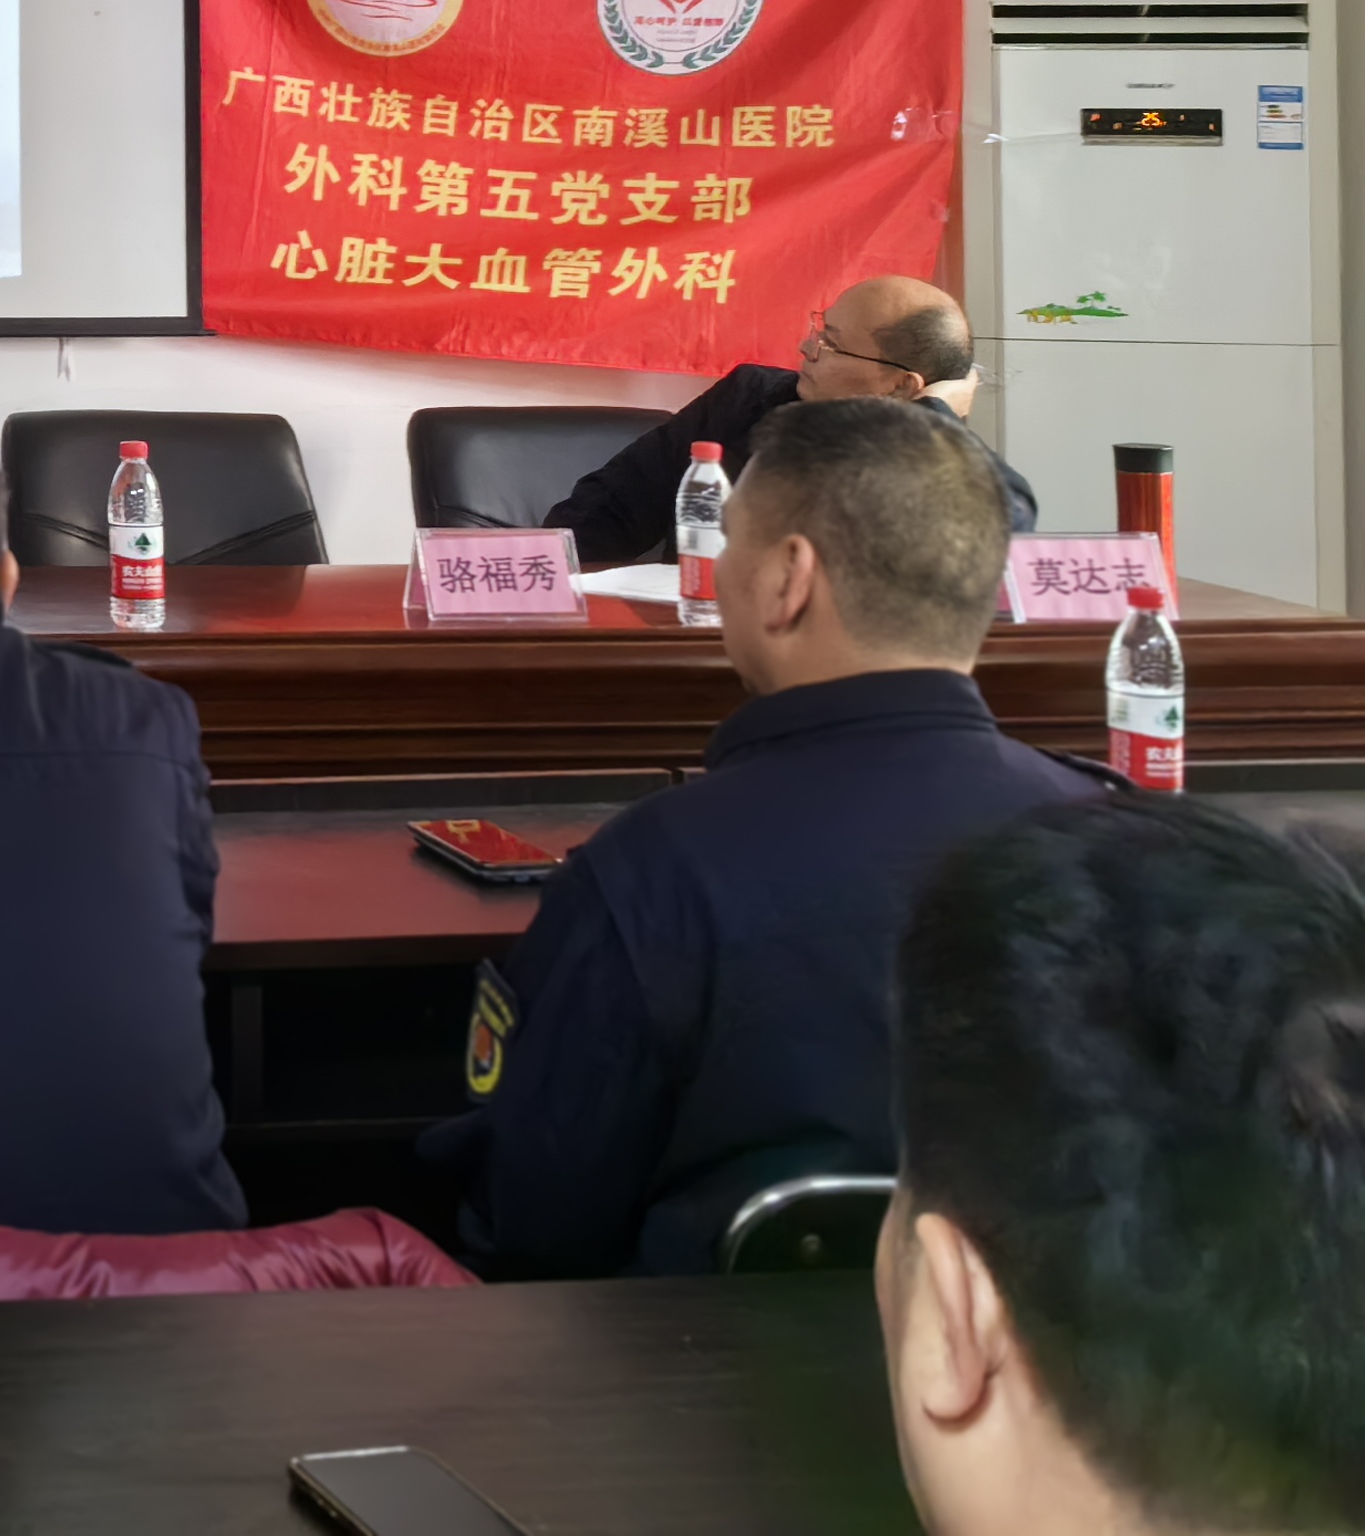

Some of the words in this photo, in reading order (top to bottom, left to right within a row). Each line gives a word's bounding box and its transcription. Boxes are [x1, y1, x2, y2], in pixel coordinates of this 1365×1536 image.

[222, 67, 836, 150] 广西壮族自治区南溪山医院
[284, 143, 754, 226] 外科第五党支部
[271, 230, 738, 304] 心脏大血管外科
[437, 554, 558, 594] 骆福秀
[1027, 558, 1151, 596] 莫达志
